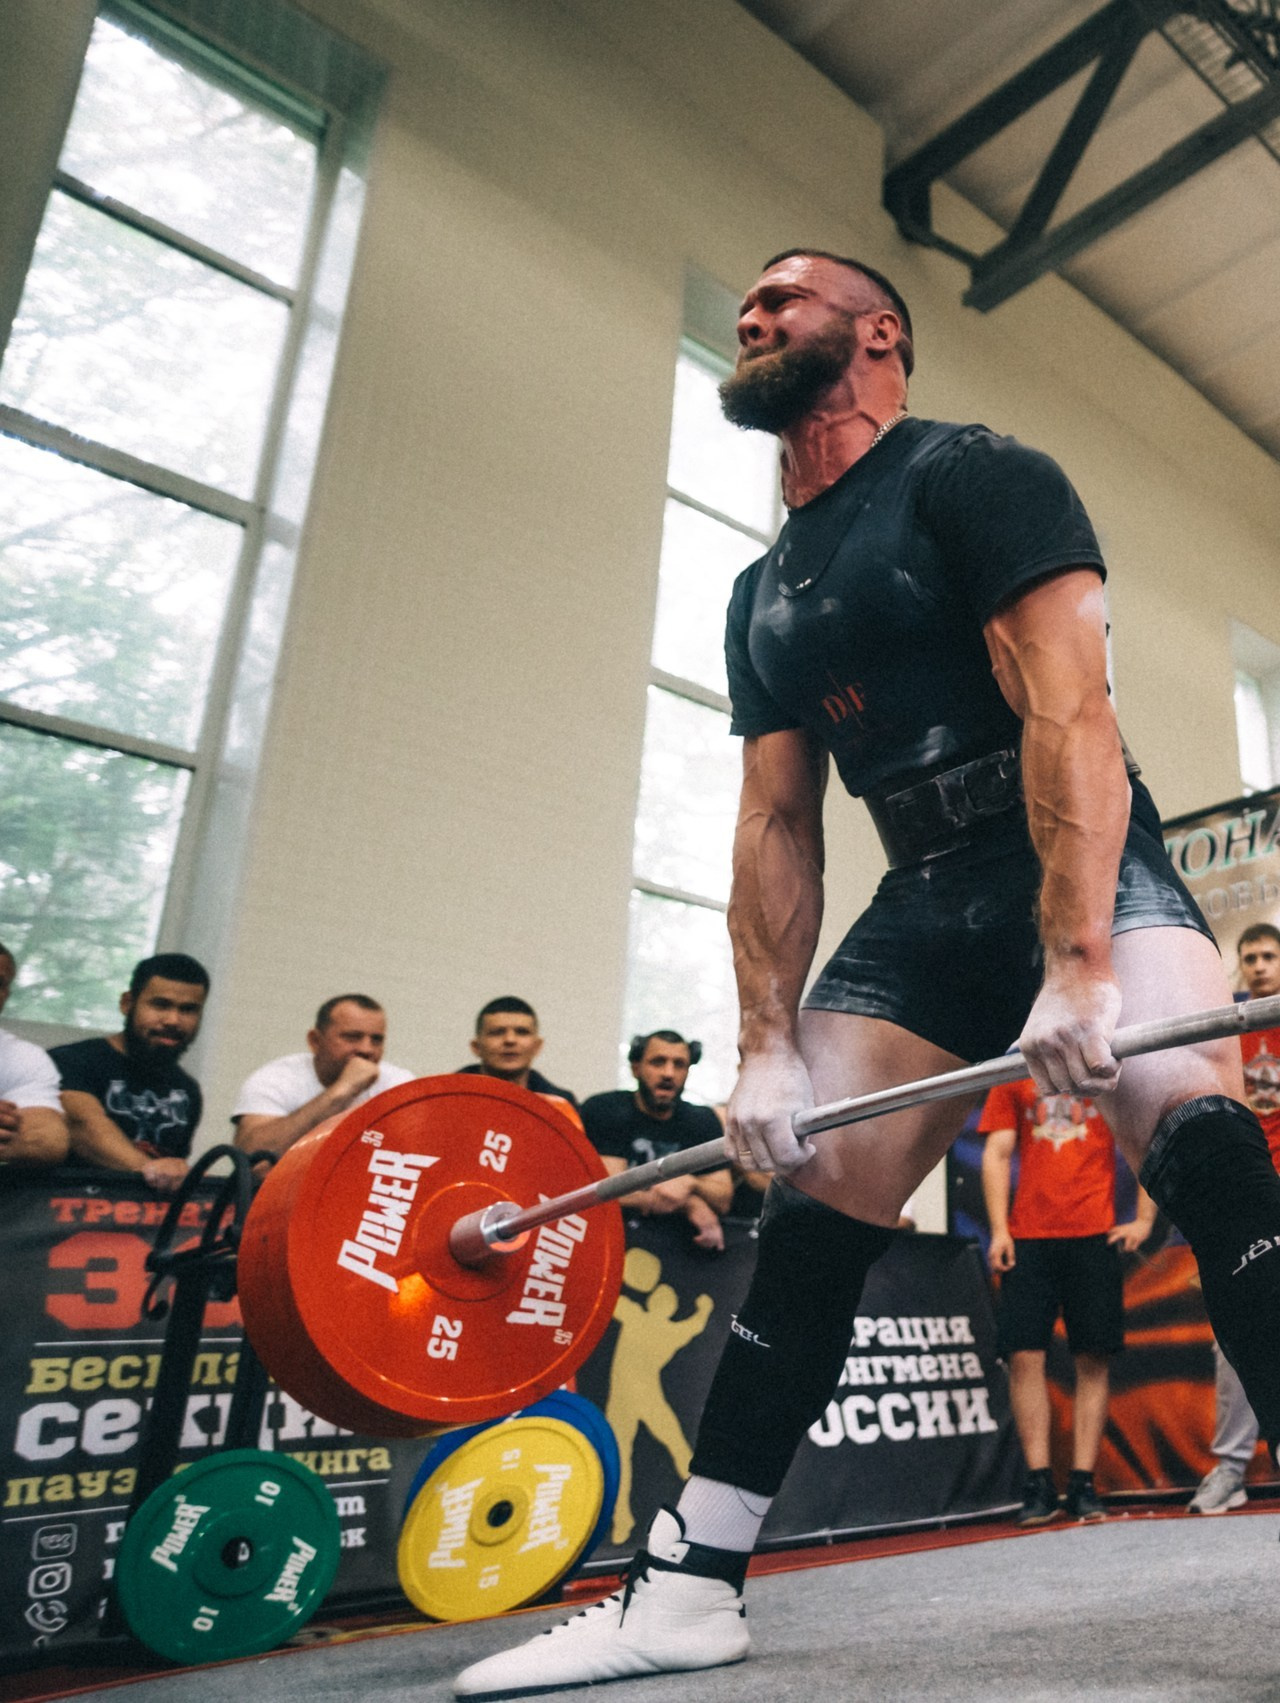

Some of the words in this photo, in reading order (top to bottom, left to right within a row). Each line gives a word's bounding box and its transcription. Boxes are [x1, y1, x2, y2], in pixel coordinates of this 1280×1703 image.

[479, 1129, 512, 1173] 25
[337, 1149, 441, 1293] POWER
[506, 1193, 588, 1327] POWER
[427, 1315, 463, 1361] 25
[851, 1316, 975, 1352] рация
[808, 1387, 998, 1447] ОССИИ
[254, 1480, 282, 1507] 10
[150, 1502, 212, 1573] POWER
[263, 1536, 317, 1602] POWER
[192, 1605, 220, 1632] 10
